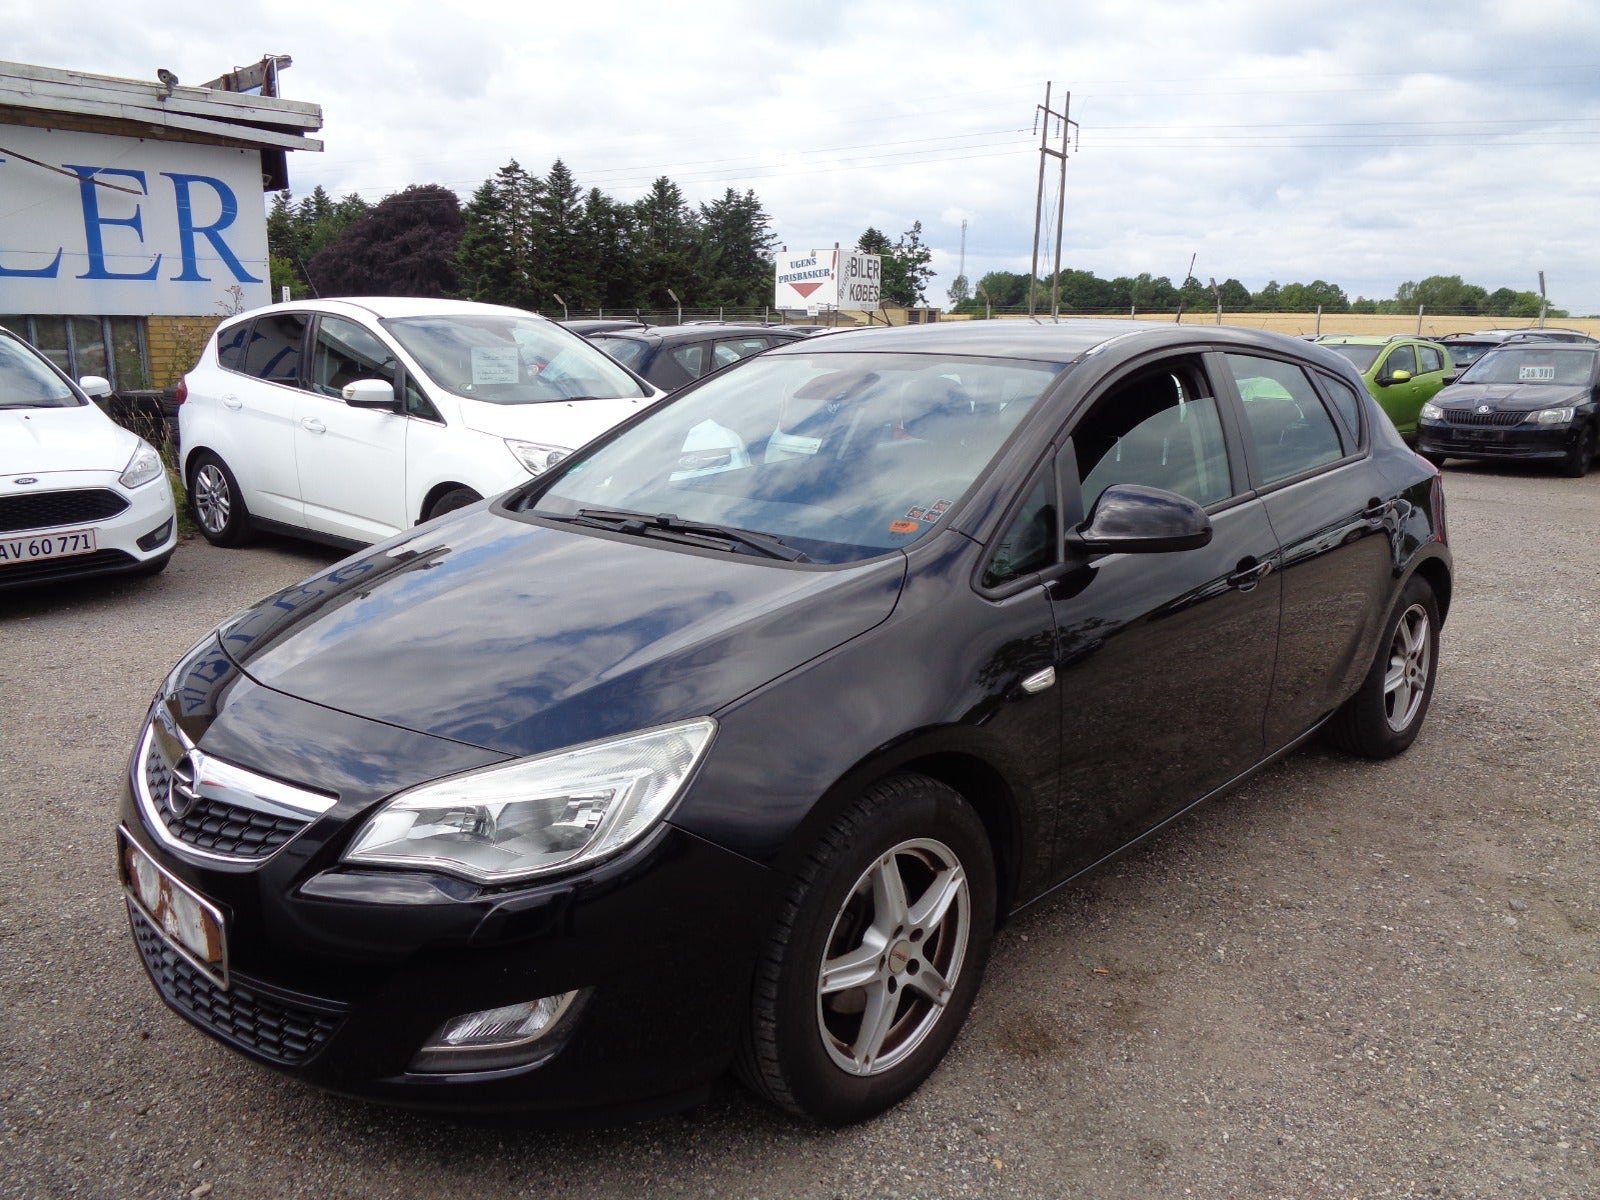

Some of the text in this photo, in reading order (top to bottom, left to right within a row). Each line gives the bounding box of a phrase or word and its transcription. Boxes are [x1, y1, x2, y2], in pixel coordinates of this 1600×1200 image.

[789, 258, 817, 269] UGENS
[850, 257, 880, 279] BILER
[778, 268, 831, 284] PRISBASKER
[849, 283, 879, 302] KØBES
[28, 539, 53, 556] 60
[57, 533, 91, 553] 771
